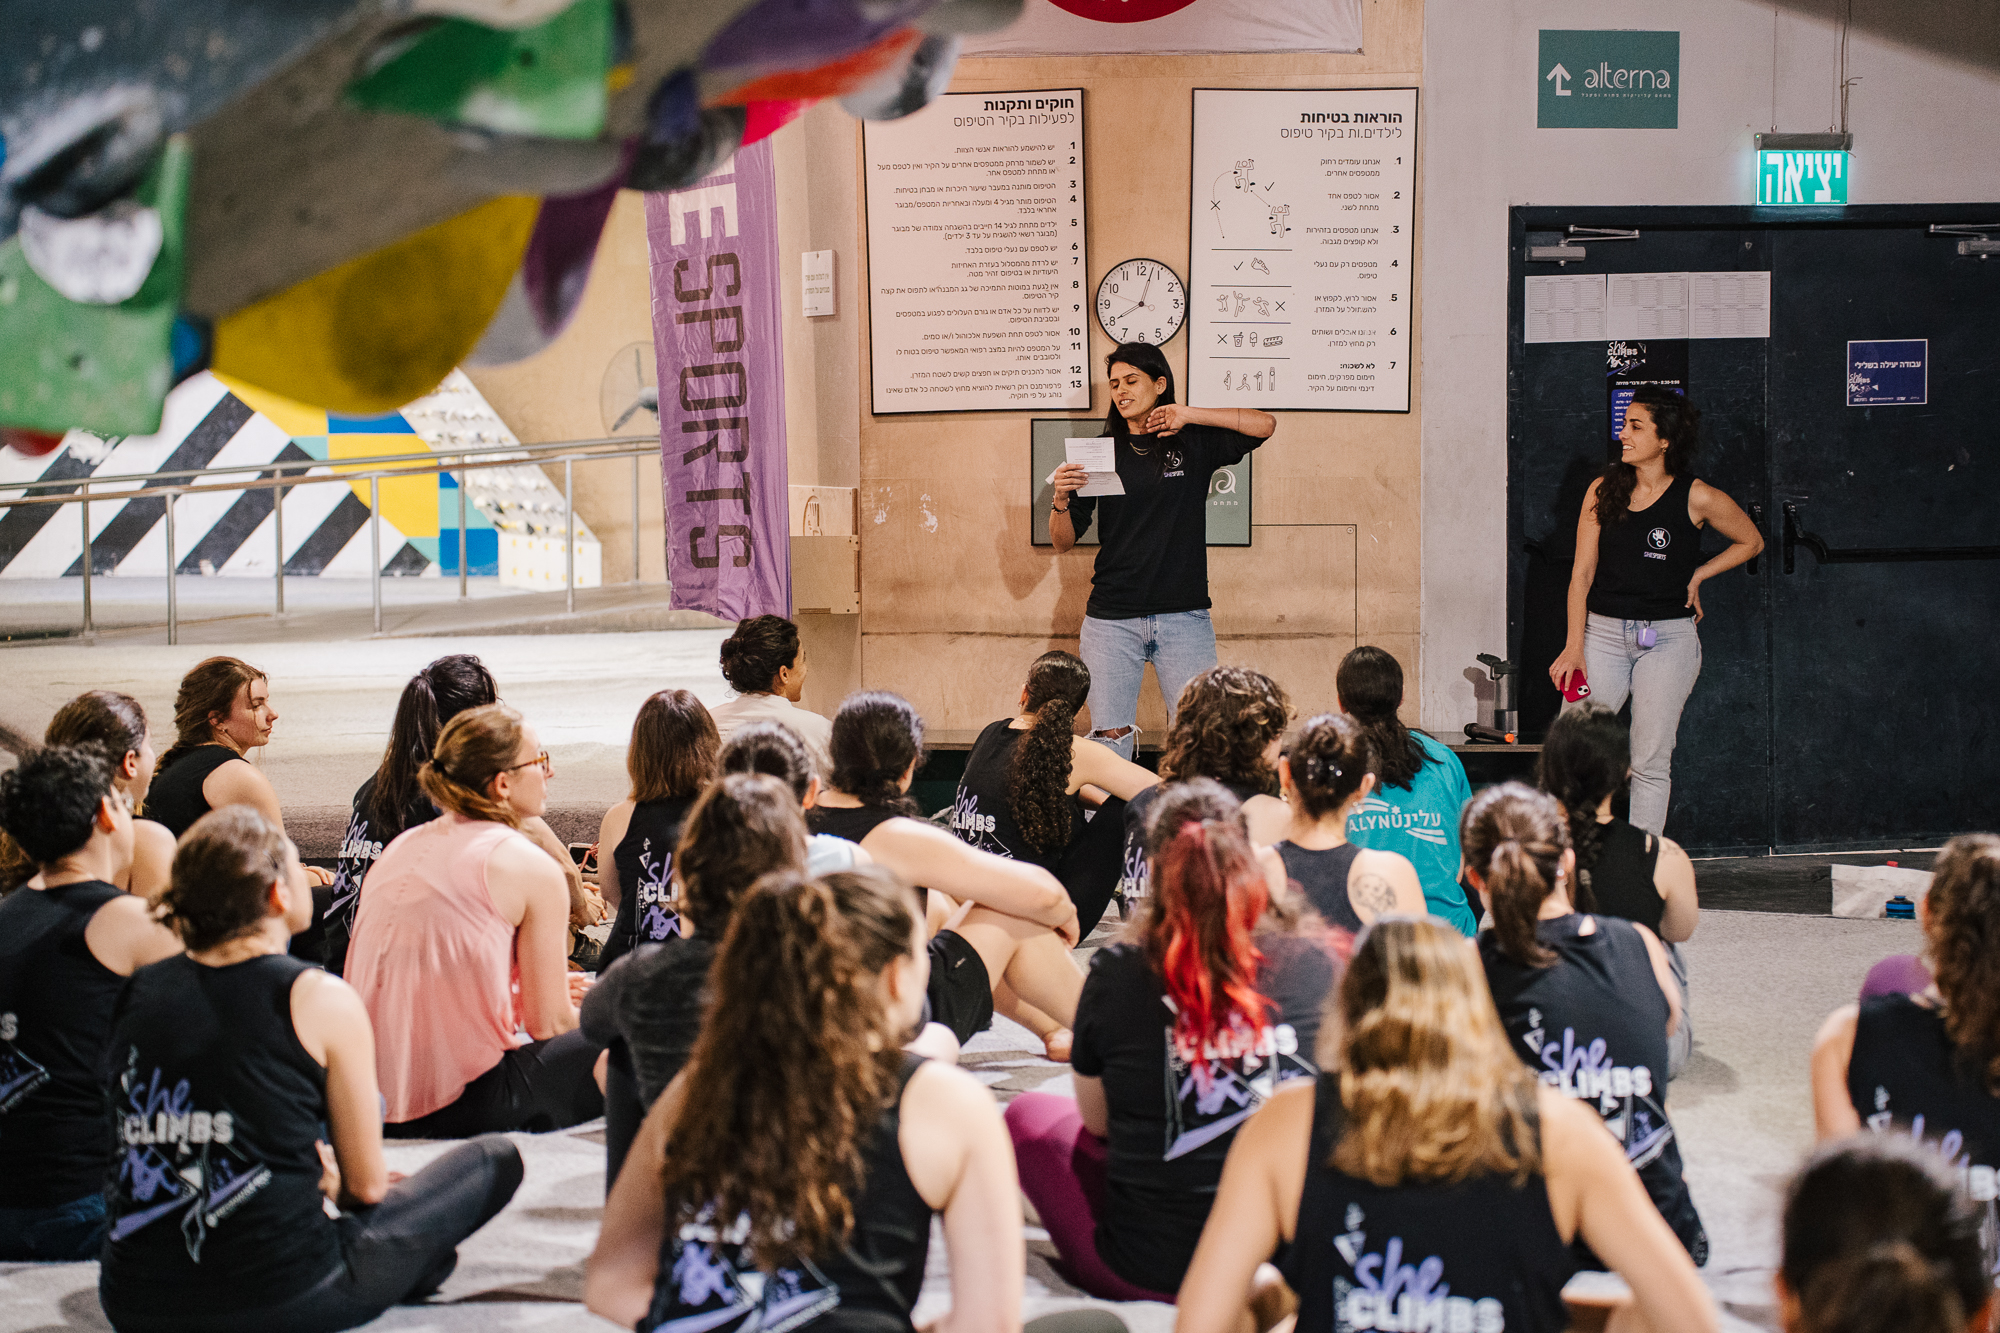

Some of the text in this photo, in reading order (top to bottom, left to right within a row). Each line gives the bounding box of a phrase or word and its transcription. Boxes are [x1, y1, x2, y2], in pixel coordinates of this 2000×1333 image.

[1583, 62, 1670, 88] alterna
[984, 98, 1074, 113] חוקים ותקנות
[953, 111, 1074, 127] לפעילות בקיר הטיפוס
[1300, 112, 1402, 124] הוראות בטיחות
[1280, 126, 1402, 140] לילדים.ות בקיר טיפוס
[1320, 158, 1336, 166] רחוק
[1766, 152, 1842, 203] יציאה
[1343, 192, 1362, 200] לטפס
[1343, 238, 1366, 246] קופצים
[1314, 260, 1328, 268] נעלי
[1137, 266, 1147, 275] 12
[1123, 271, 1129, 281] 11
[1110, 284, 1119, 293] 10
[1167, 282, 1174, 292] 2
[1104, 299, 1110, 309] 9
[1173, 299, 1179, 309] 3
[1109, 316, 1115, 326] 8
[1167, 316, 1174, 326] 4
[1122, 328, 1128, 338] 7
[1138, 332, 1145, 342] 6
[1155, 328, 1161, 338] 5
[1366, 340, 1376, 348] רק
[1607, 348, 1638, 356] CLIMBS
[1880, 360, 1898, 368] יעילה
[1326, 384, 1334, 392] על
[345, 812, 368, 844] he
[338, 840, 383, 860] LIMBS
[1541, 1027, 1613, 1076] she
[129, 1067, 192, 1120] she
[124, 1111, 234, 1145] CLIMBS
[1354, 1236, 1450, 1303] she
[1346, 1288, 1505, 1333] CLIMBS
